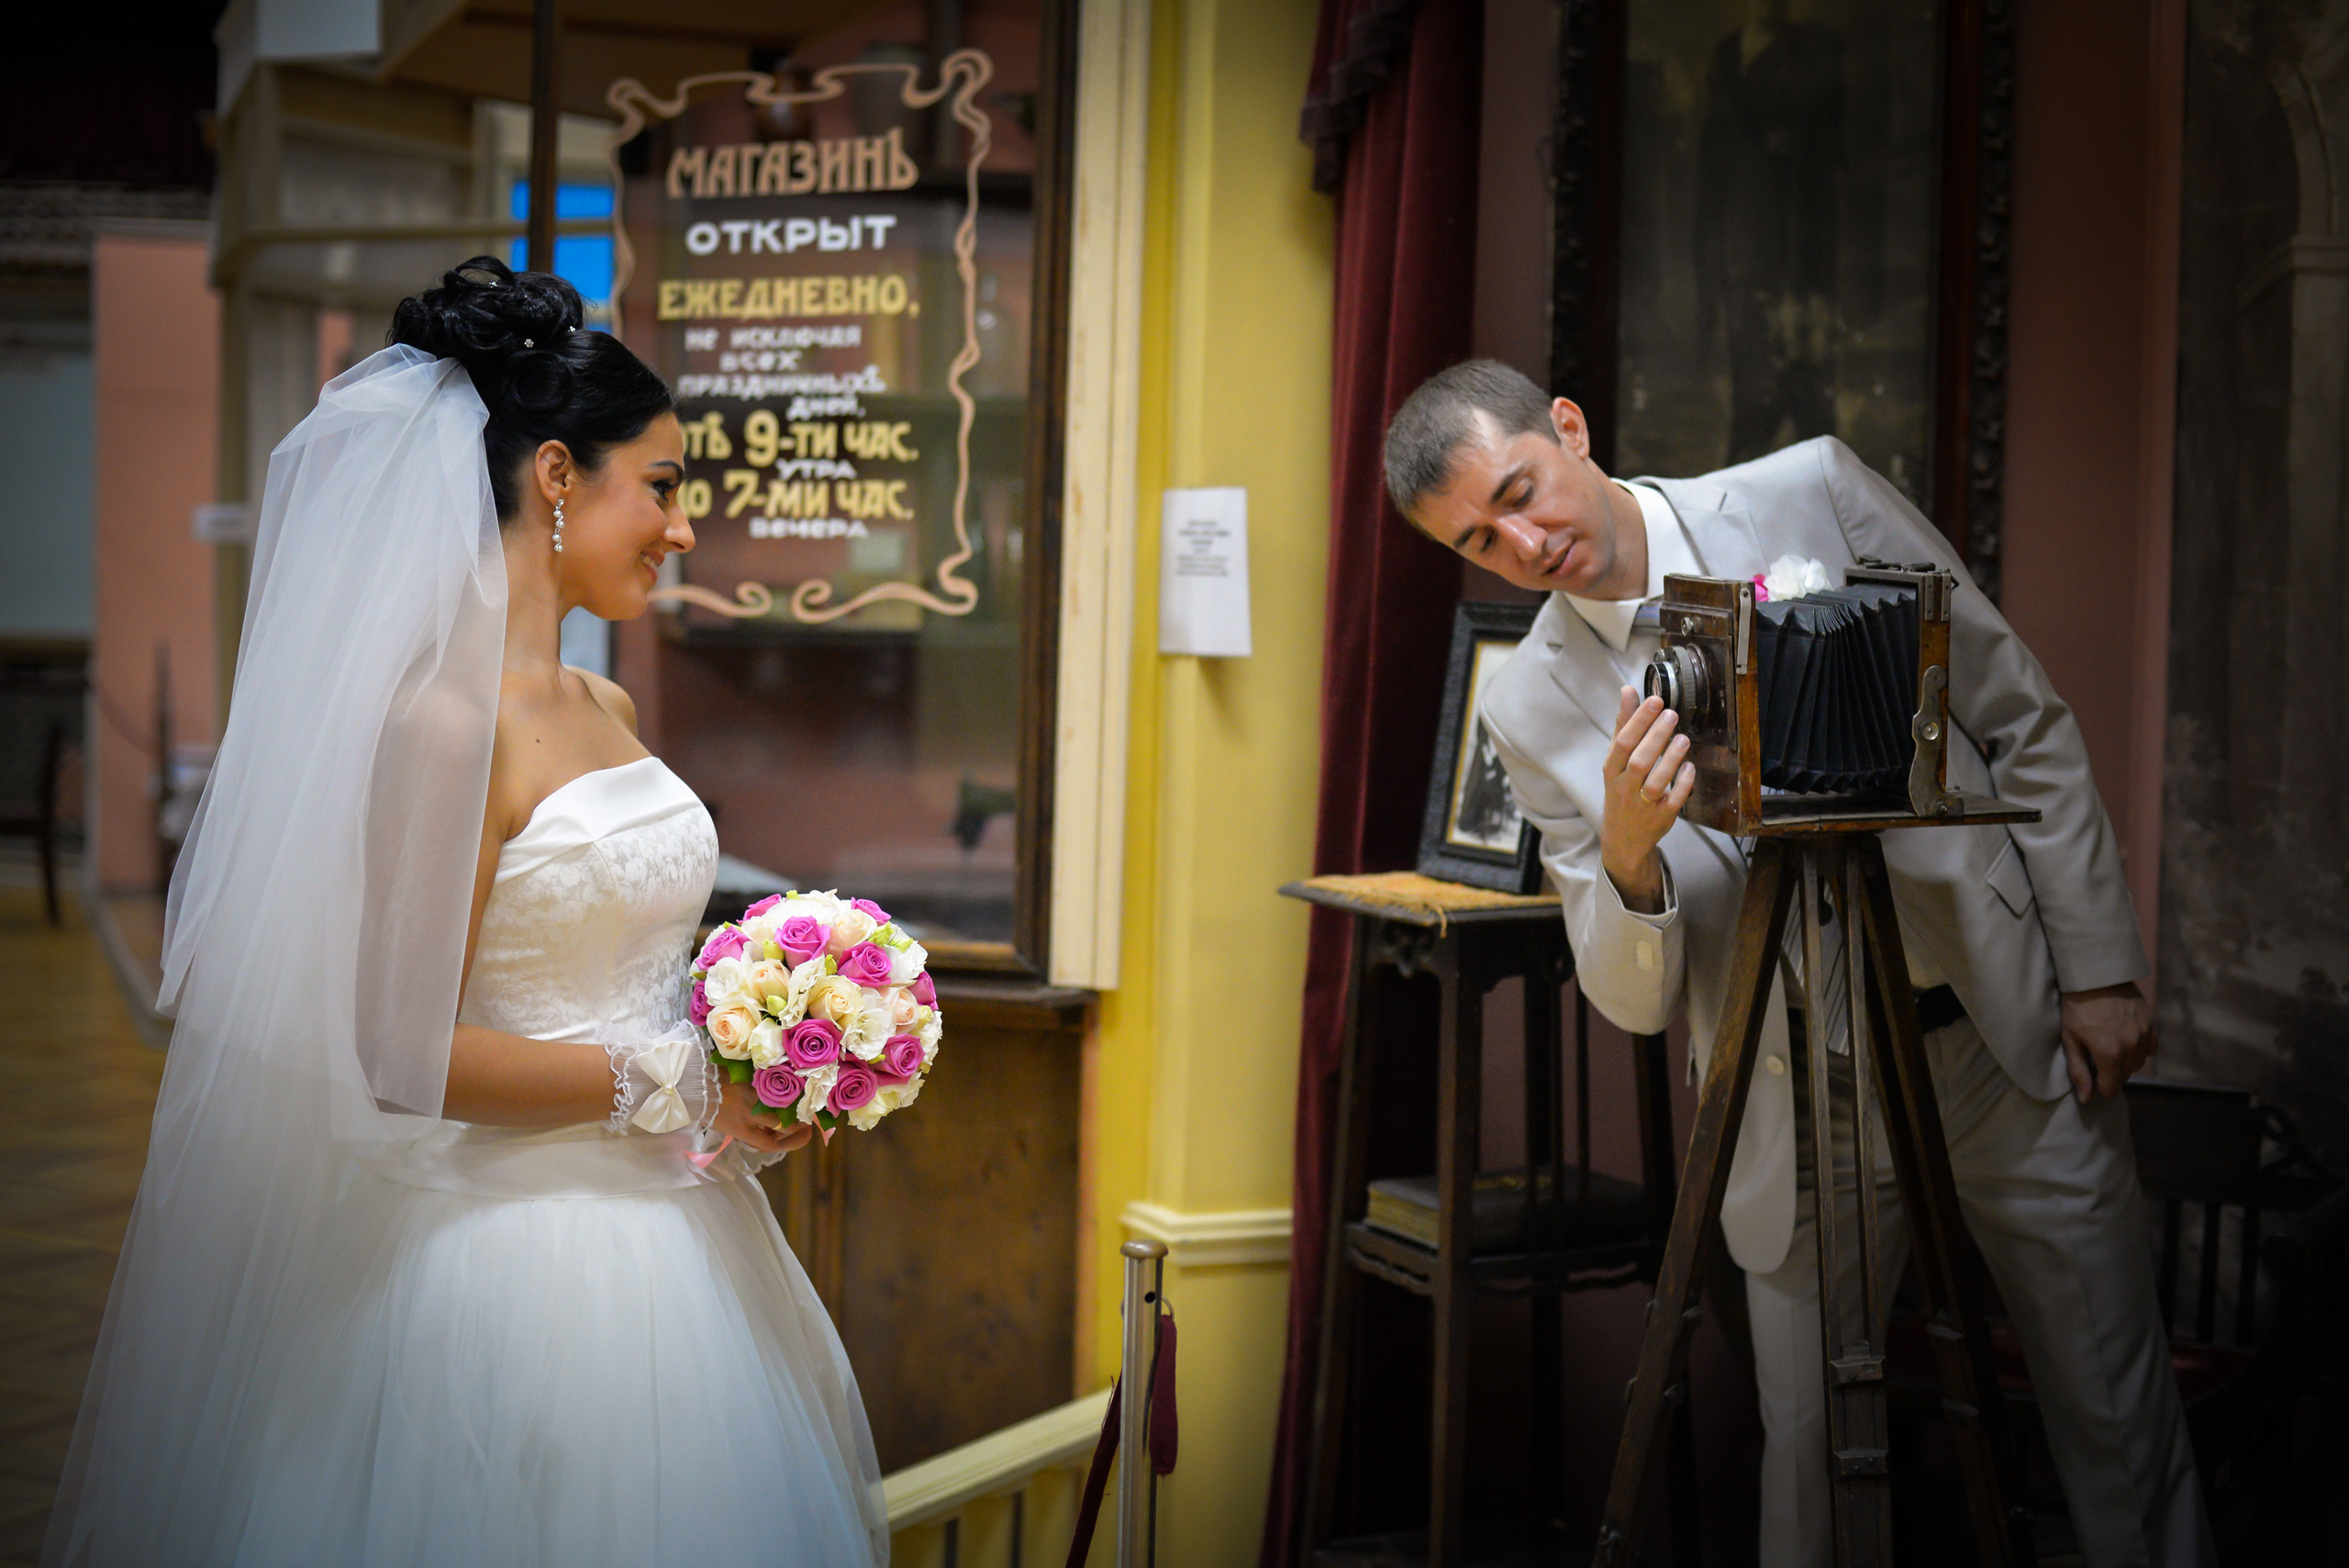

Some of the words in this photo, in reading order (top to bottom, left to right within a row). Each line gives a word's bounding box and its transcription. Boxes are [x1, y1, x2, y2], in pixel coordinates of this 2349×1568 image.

[665, 126, 919, 199] МАГАЗИНЪ
[685, 215, 897, 256] ОТКРЫТ
[775, 458, 858, 481] УТРА
